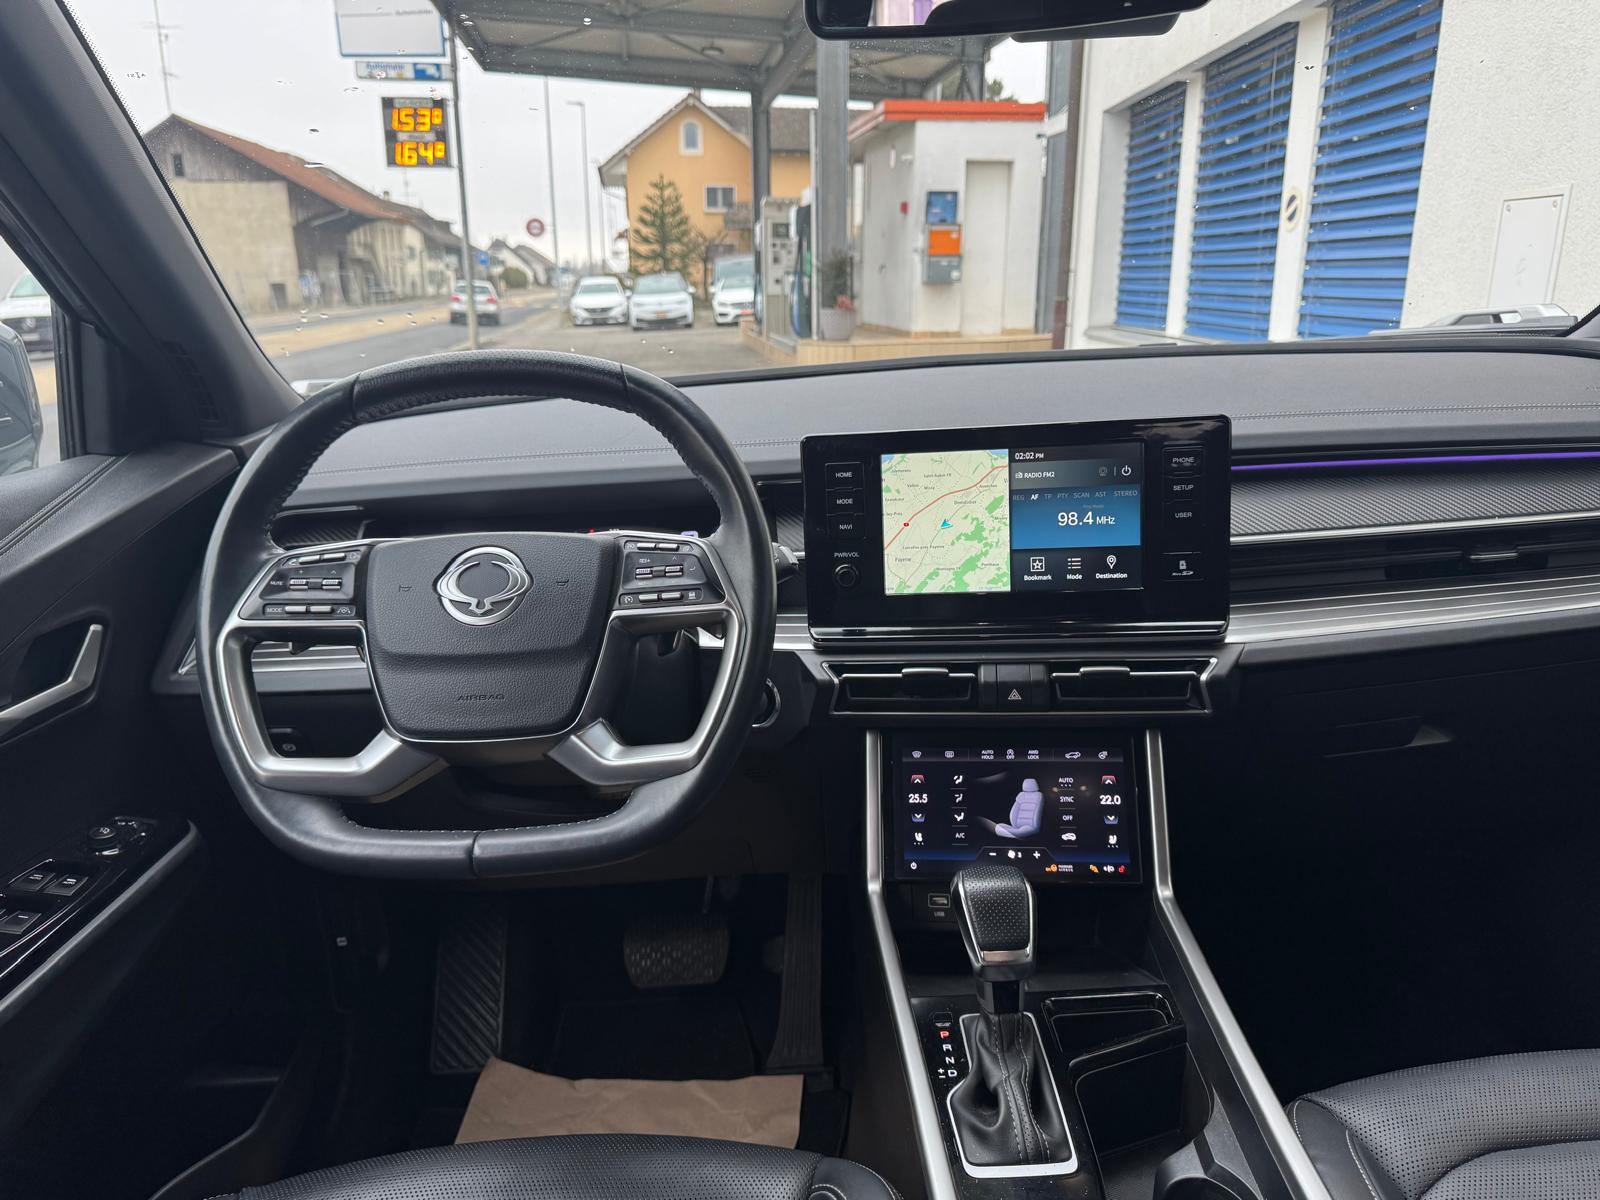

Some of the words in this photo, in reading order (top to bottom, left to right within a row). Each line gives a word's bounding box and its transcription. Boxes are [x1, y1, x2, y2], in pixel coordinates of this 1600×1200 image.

[1015, 452, 1034, 460] 02:02
[1030, 493, 1039, 501] AF
[1057, 492, 1069, 500] PTY
[1073, 491, 1090, 499] SCAN
[1113, 489, 1138, 497] STEREO
[1057, 511, 1094, 527] 98.4
[1096, 515, 1116, 525] MHz
[1174, 511, 1193, 519] USER
[1023, 573, 1052, 581] Bookmark
[1095, 571, 1128, 579] Destination
[908, 793, 928, 804] 25.5
[1099, 795, 1121, 805] 22.0
[940, 1031, 949, 1039] P
[942, 1044, 952, 1052] R
[945, 1056, 955, 1065] N
[947, 1069, 957, 1077] D
